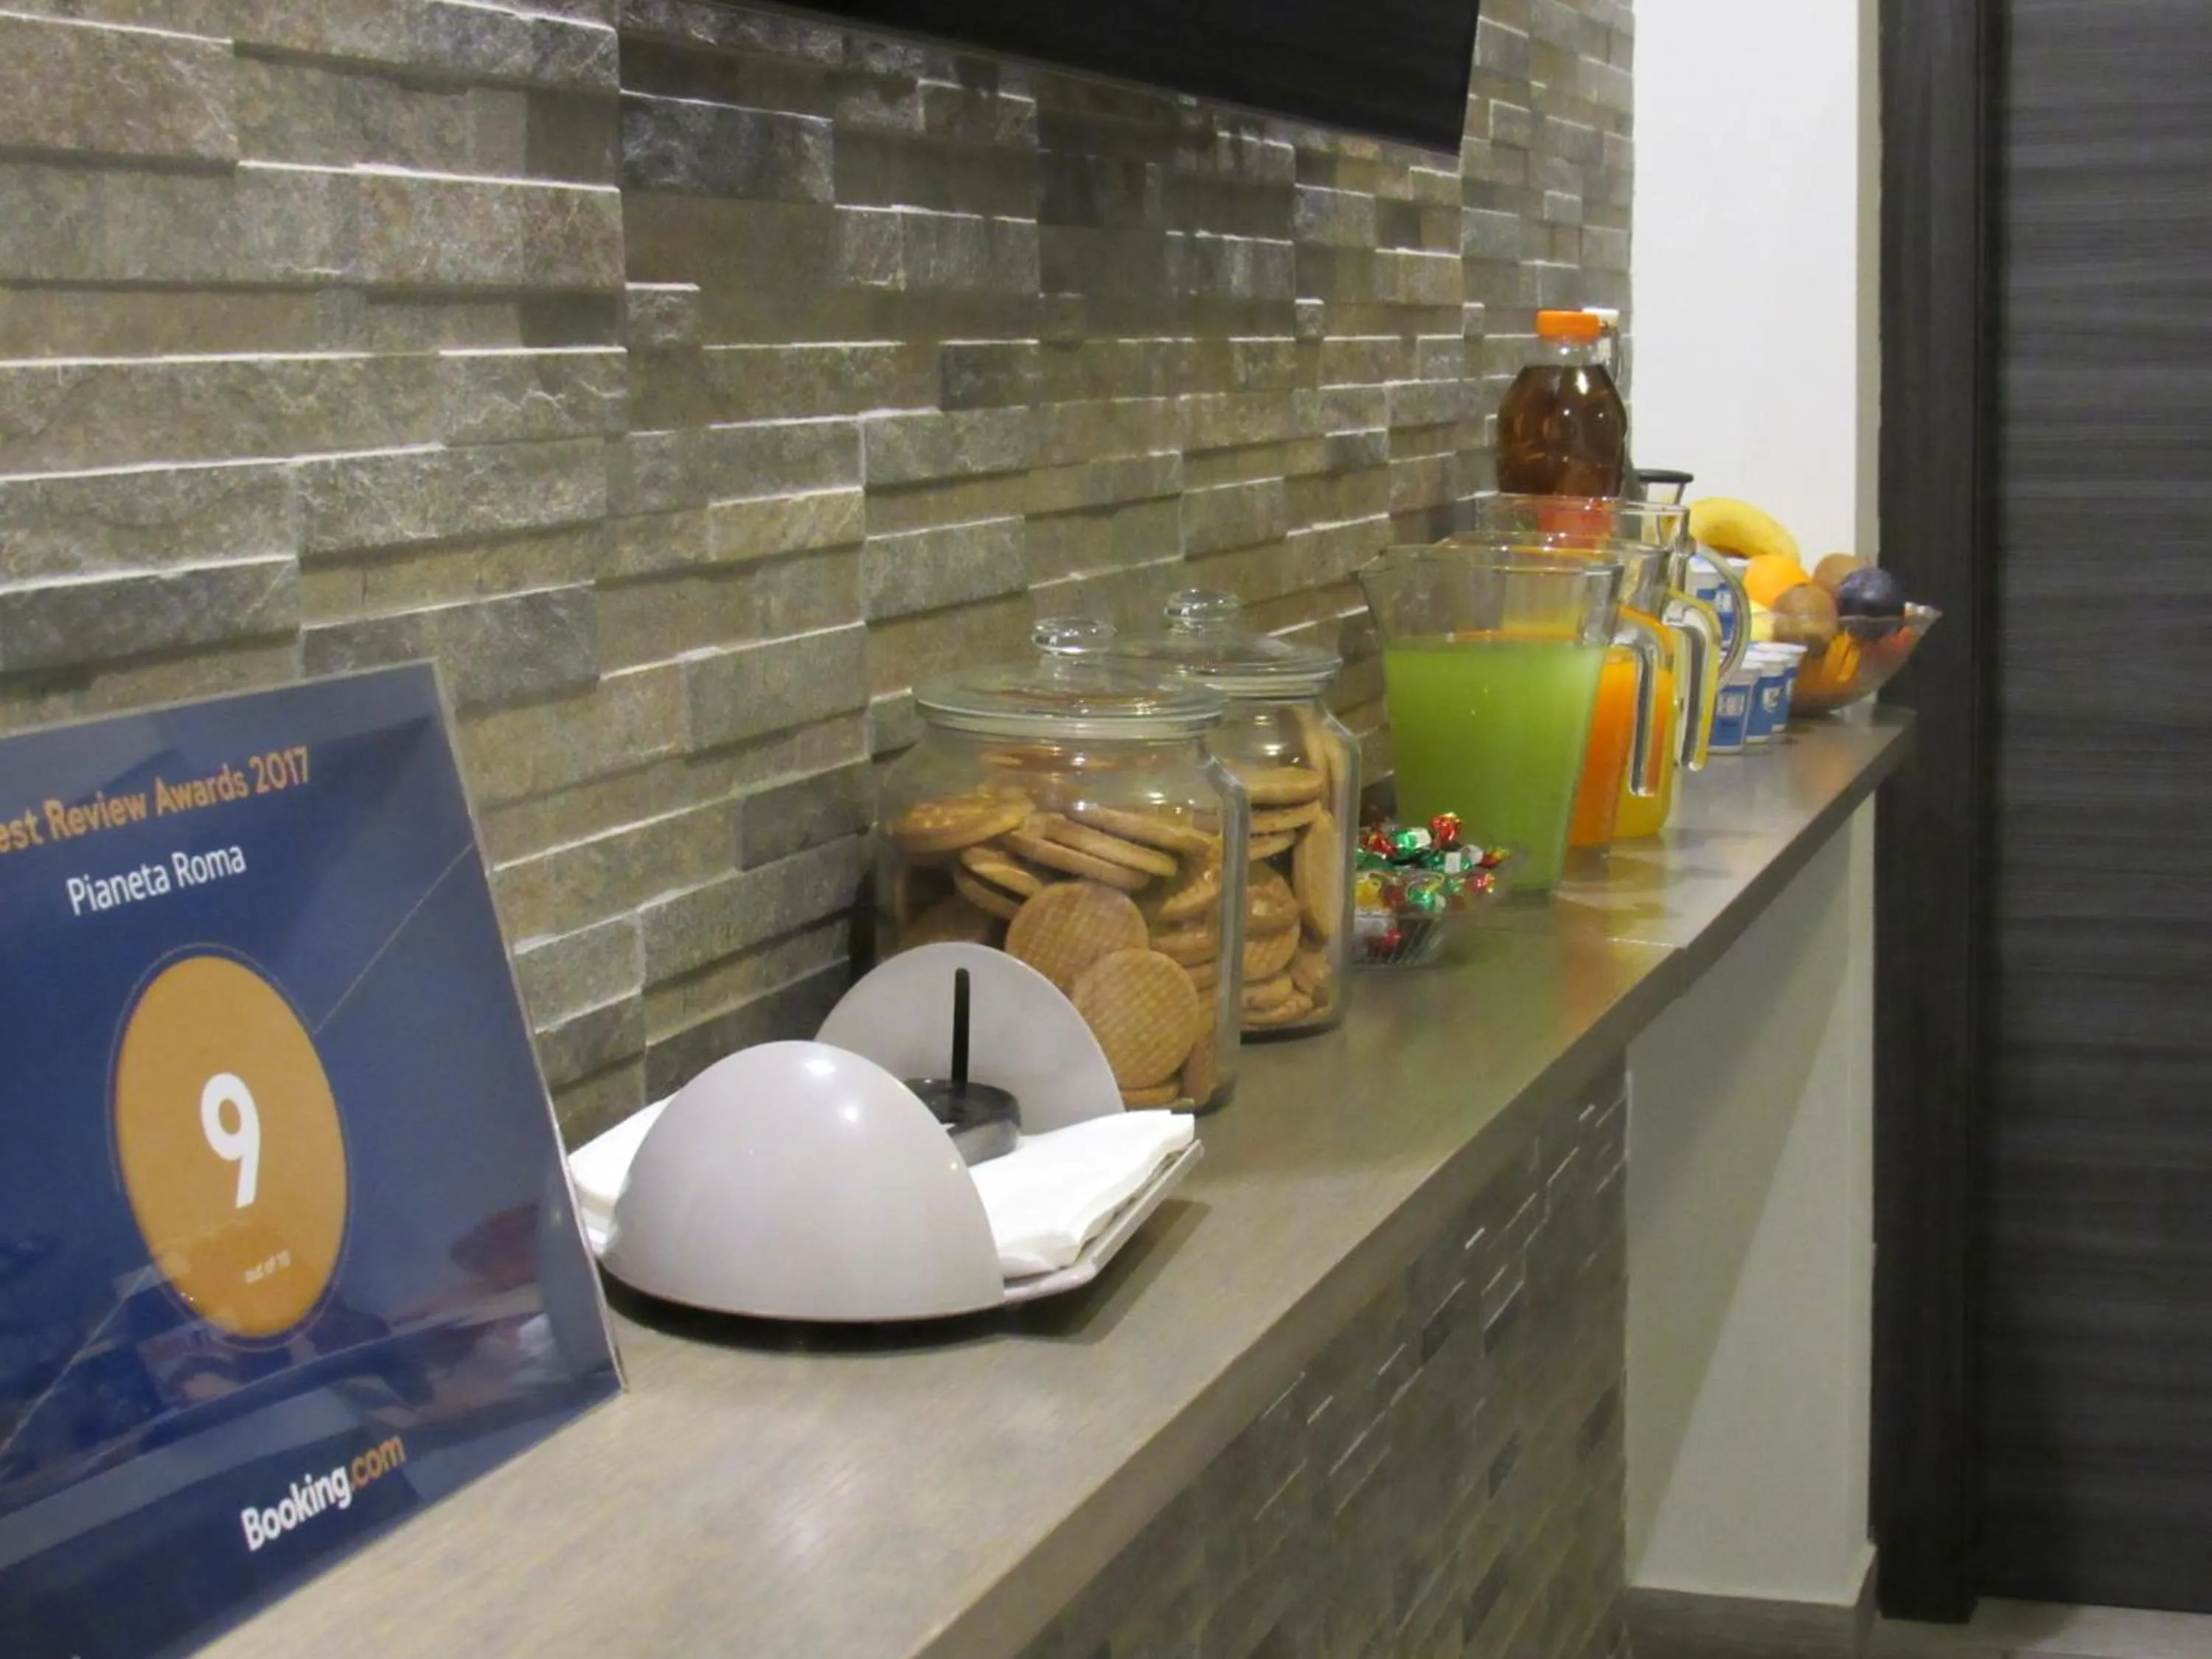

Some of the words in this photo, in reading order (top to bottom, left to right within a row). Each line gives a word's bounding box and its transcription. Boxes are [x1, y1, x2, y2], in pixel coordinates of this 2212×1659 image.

[42, 790, 147, 841] Review
[154, 762, 249, 816] Awards
[248, 745, 310, 795] 2017
[66, 863, 171, 916] Pianeta
[170, 845, 248, 888] Roma
[201, 1072, 261, 1209] 9
[240, 1436, 406, 1552] Booking.com
